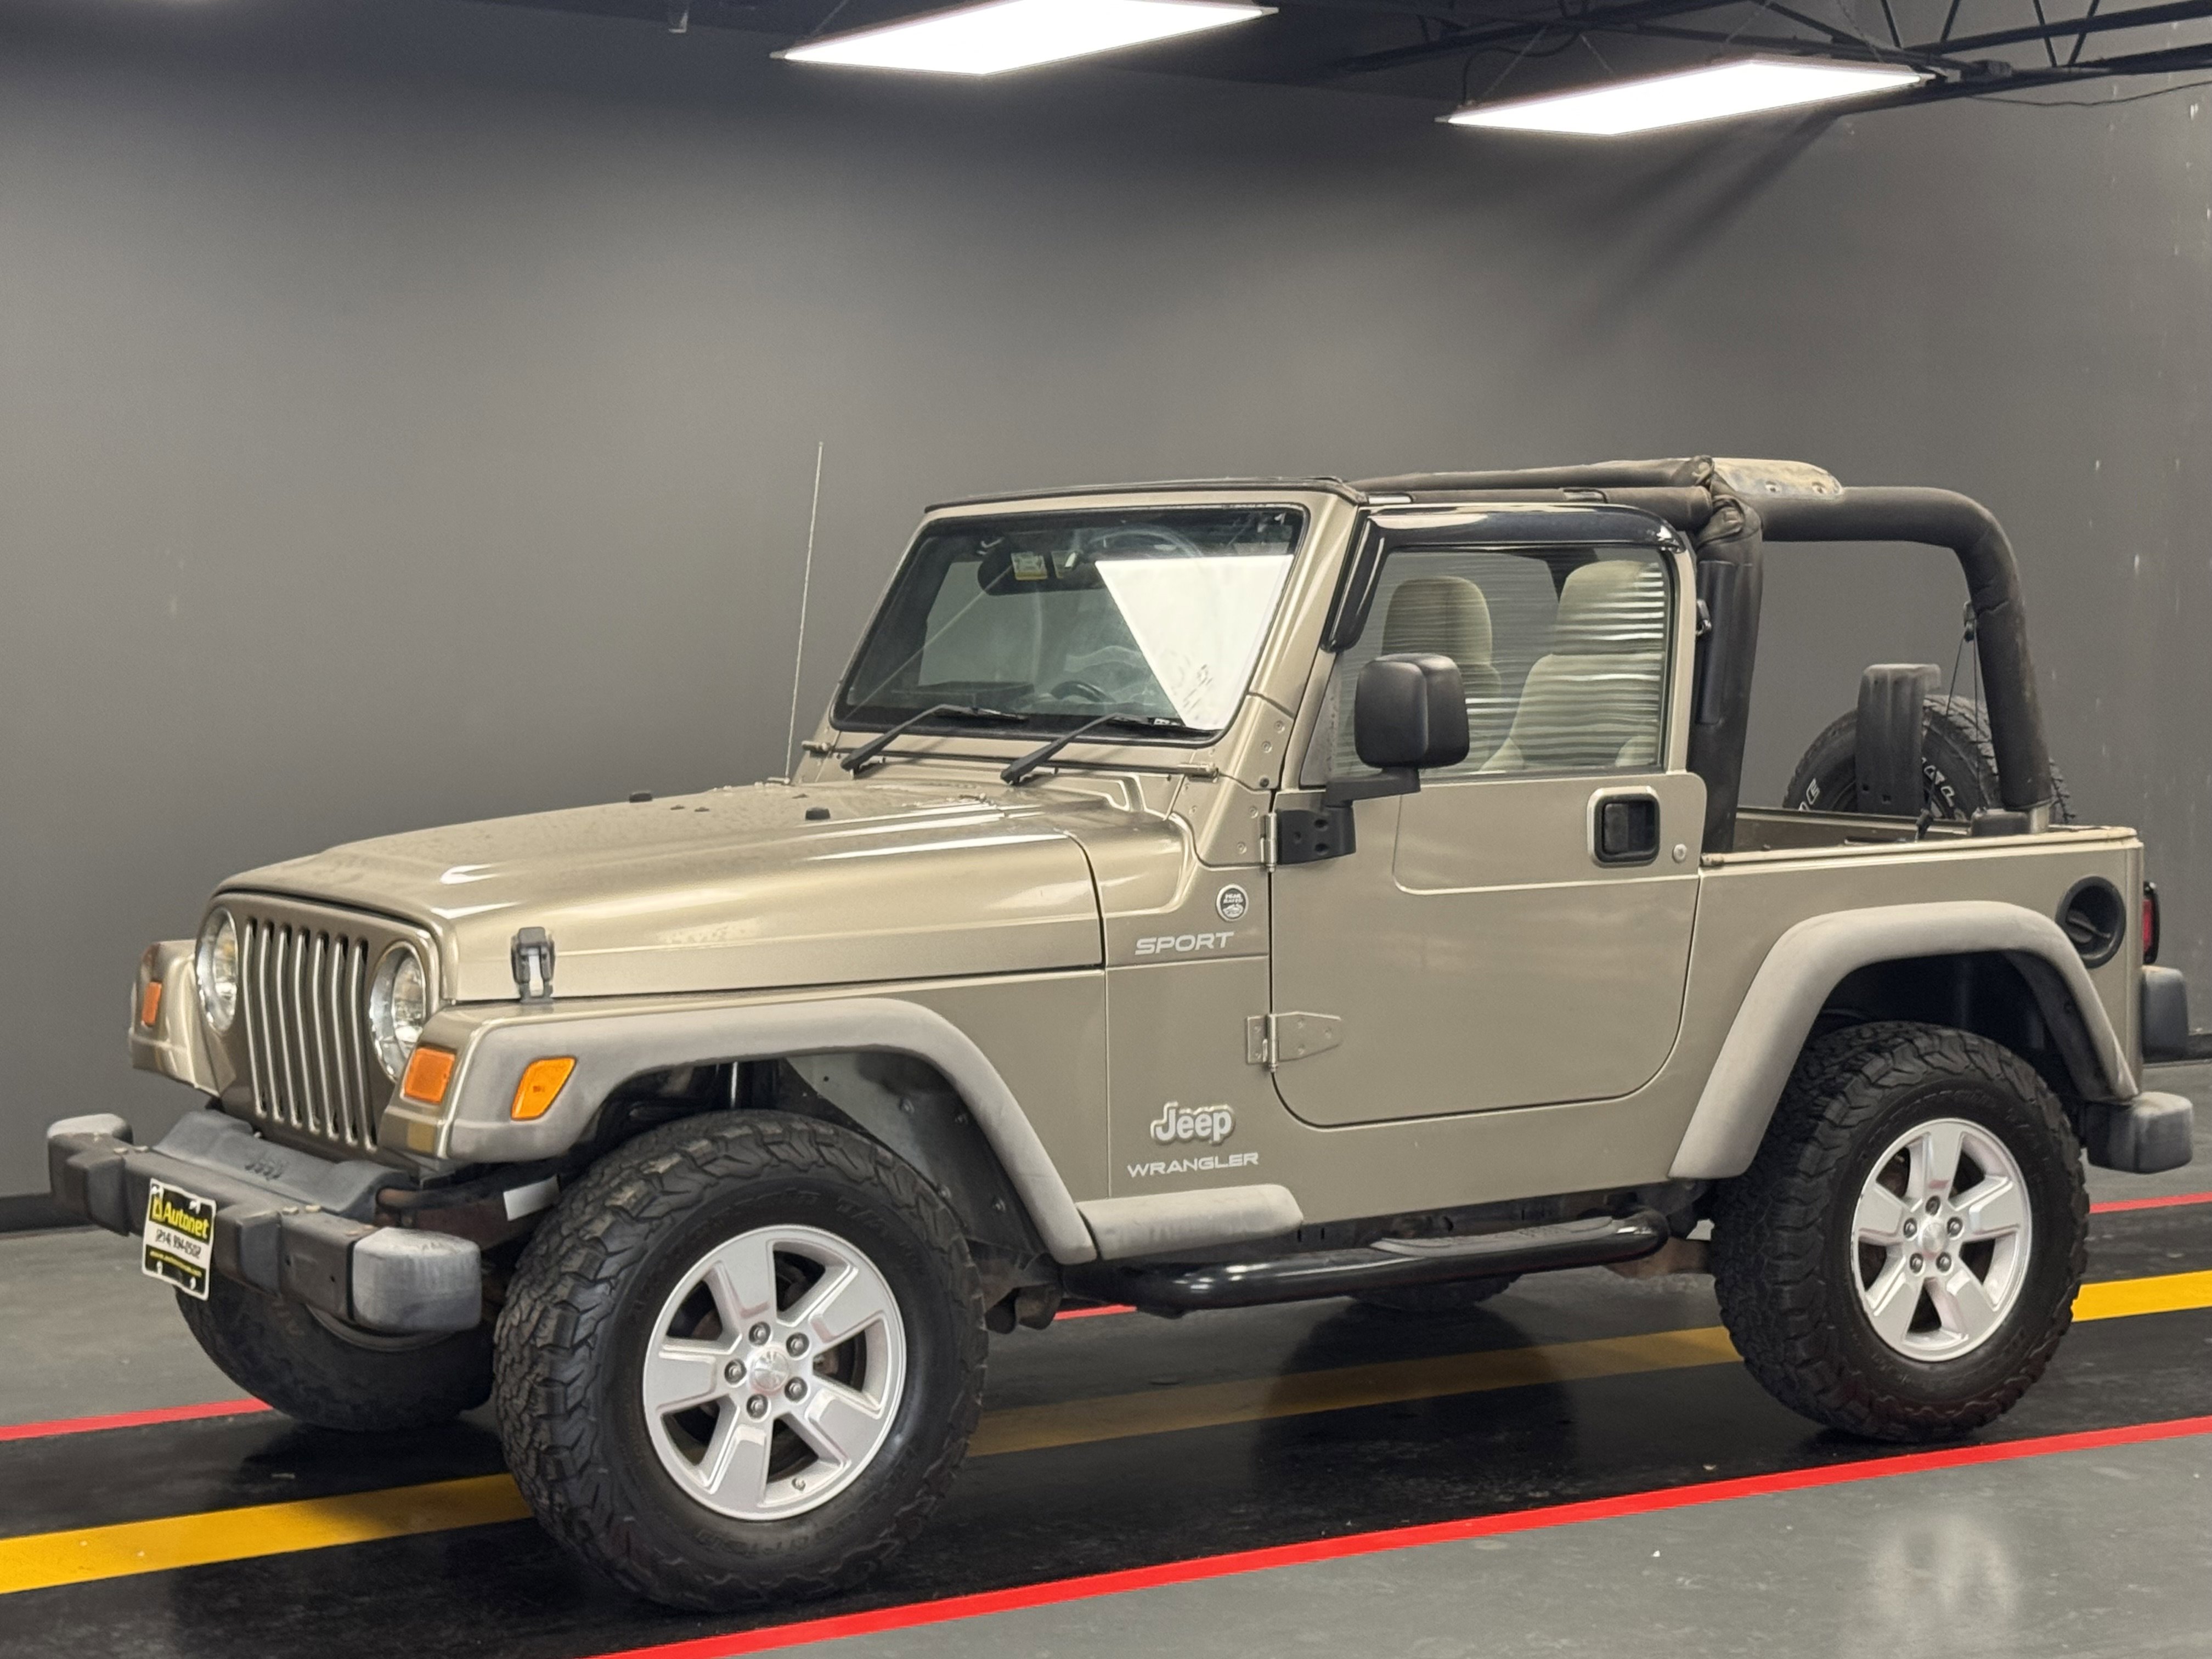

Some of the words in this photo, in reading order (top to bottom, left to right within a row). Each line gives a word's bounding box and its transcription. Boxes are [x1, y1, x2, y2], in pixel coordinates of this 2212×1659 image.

[1135, 932, 1234, 955] SPORT
[1155, 1108, 1233, 1142] Jeep
[1127, 1152, 1260, 1178] WRANGLER
[163, 1201, 209, 1239] Autonet
